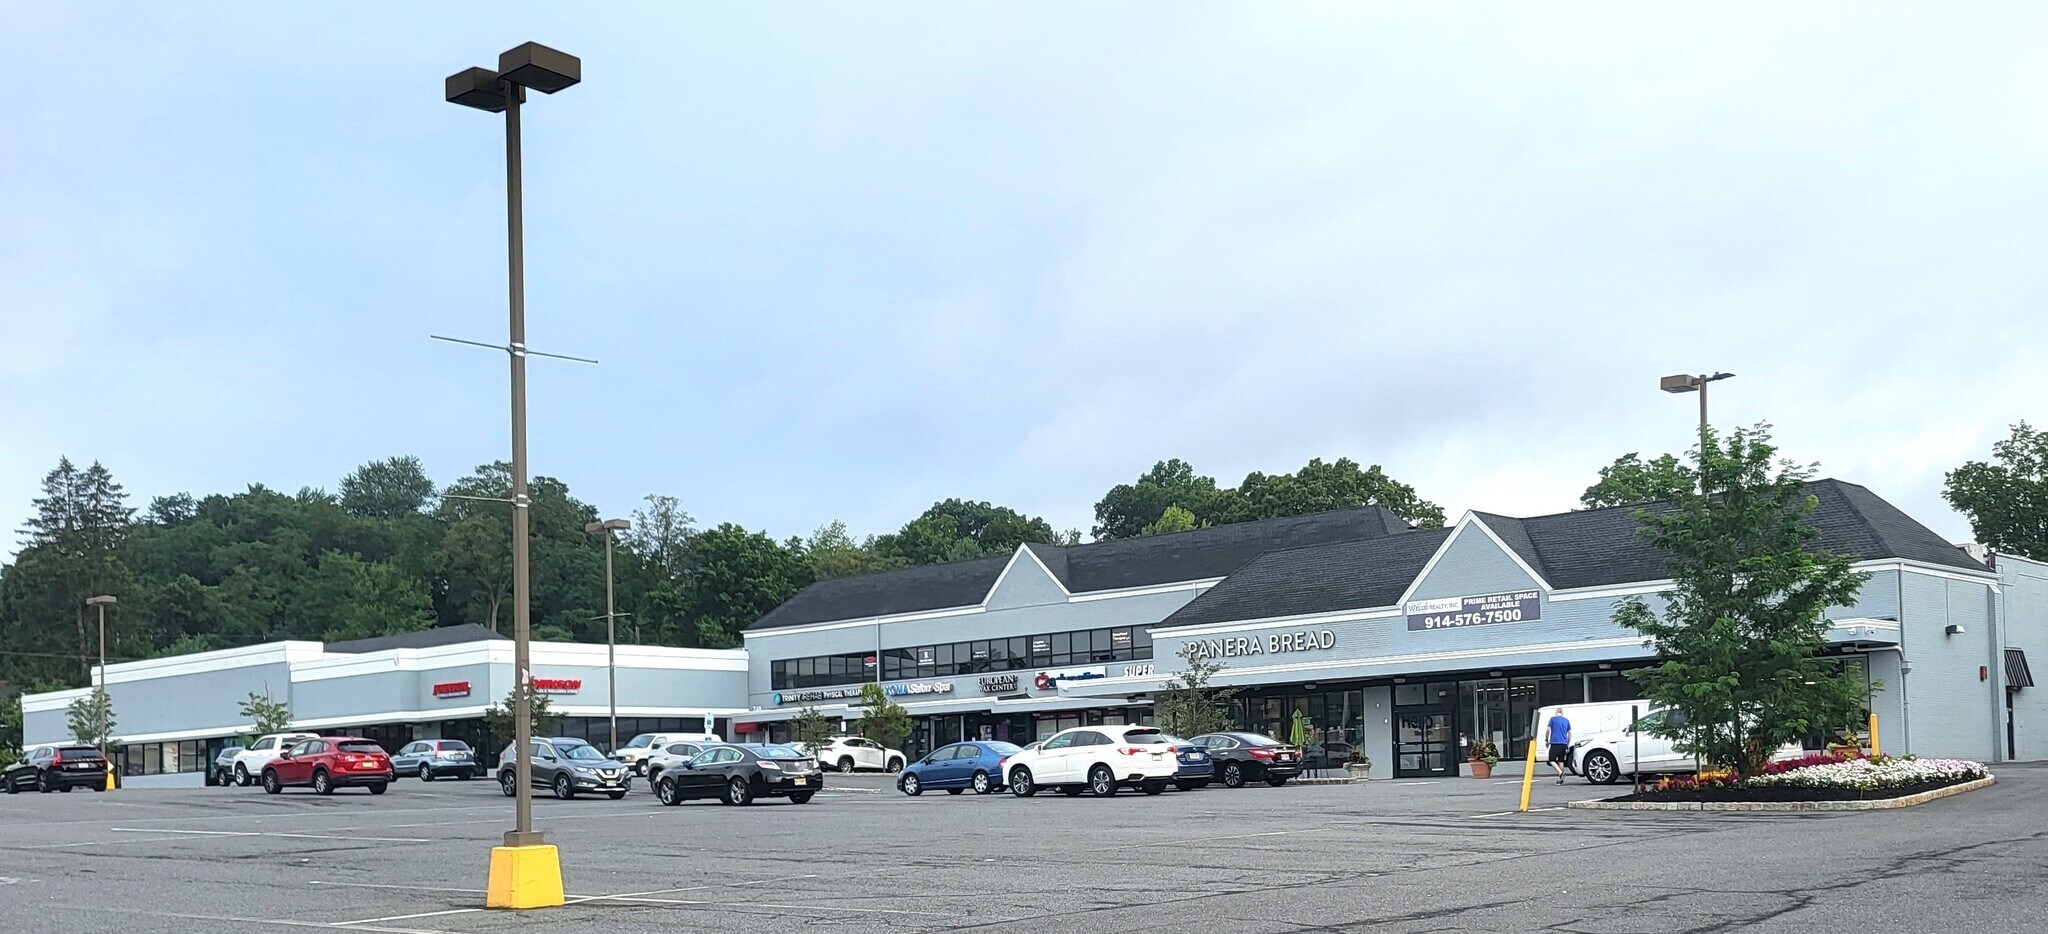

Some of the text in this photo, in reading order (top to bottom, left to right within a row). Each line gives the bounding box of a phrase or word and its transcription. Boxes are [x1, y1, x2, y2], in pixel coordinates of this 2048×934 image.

[1464, 592, 1538, 605] PRIME RETAIL SPACE
[1481, 601, 1520, 611] AVAILABLE
[1424, 609, 1521, 628] 914-576-7500
[1188, 630, 1336, 658] PANERA BREAD
[1123, 664, 1156, 677] SUPER
[978, 674, 1016, 686] EUROPEAN
[978, 683, 1016, 692] WAX CENTER
[782, 694, 801, 703] TRINITY
[801, 691, 823, 701] REHAB
[823, 690, 844, 699] PHYSICAL
